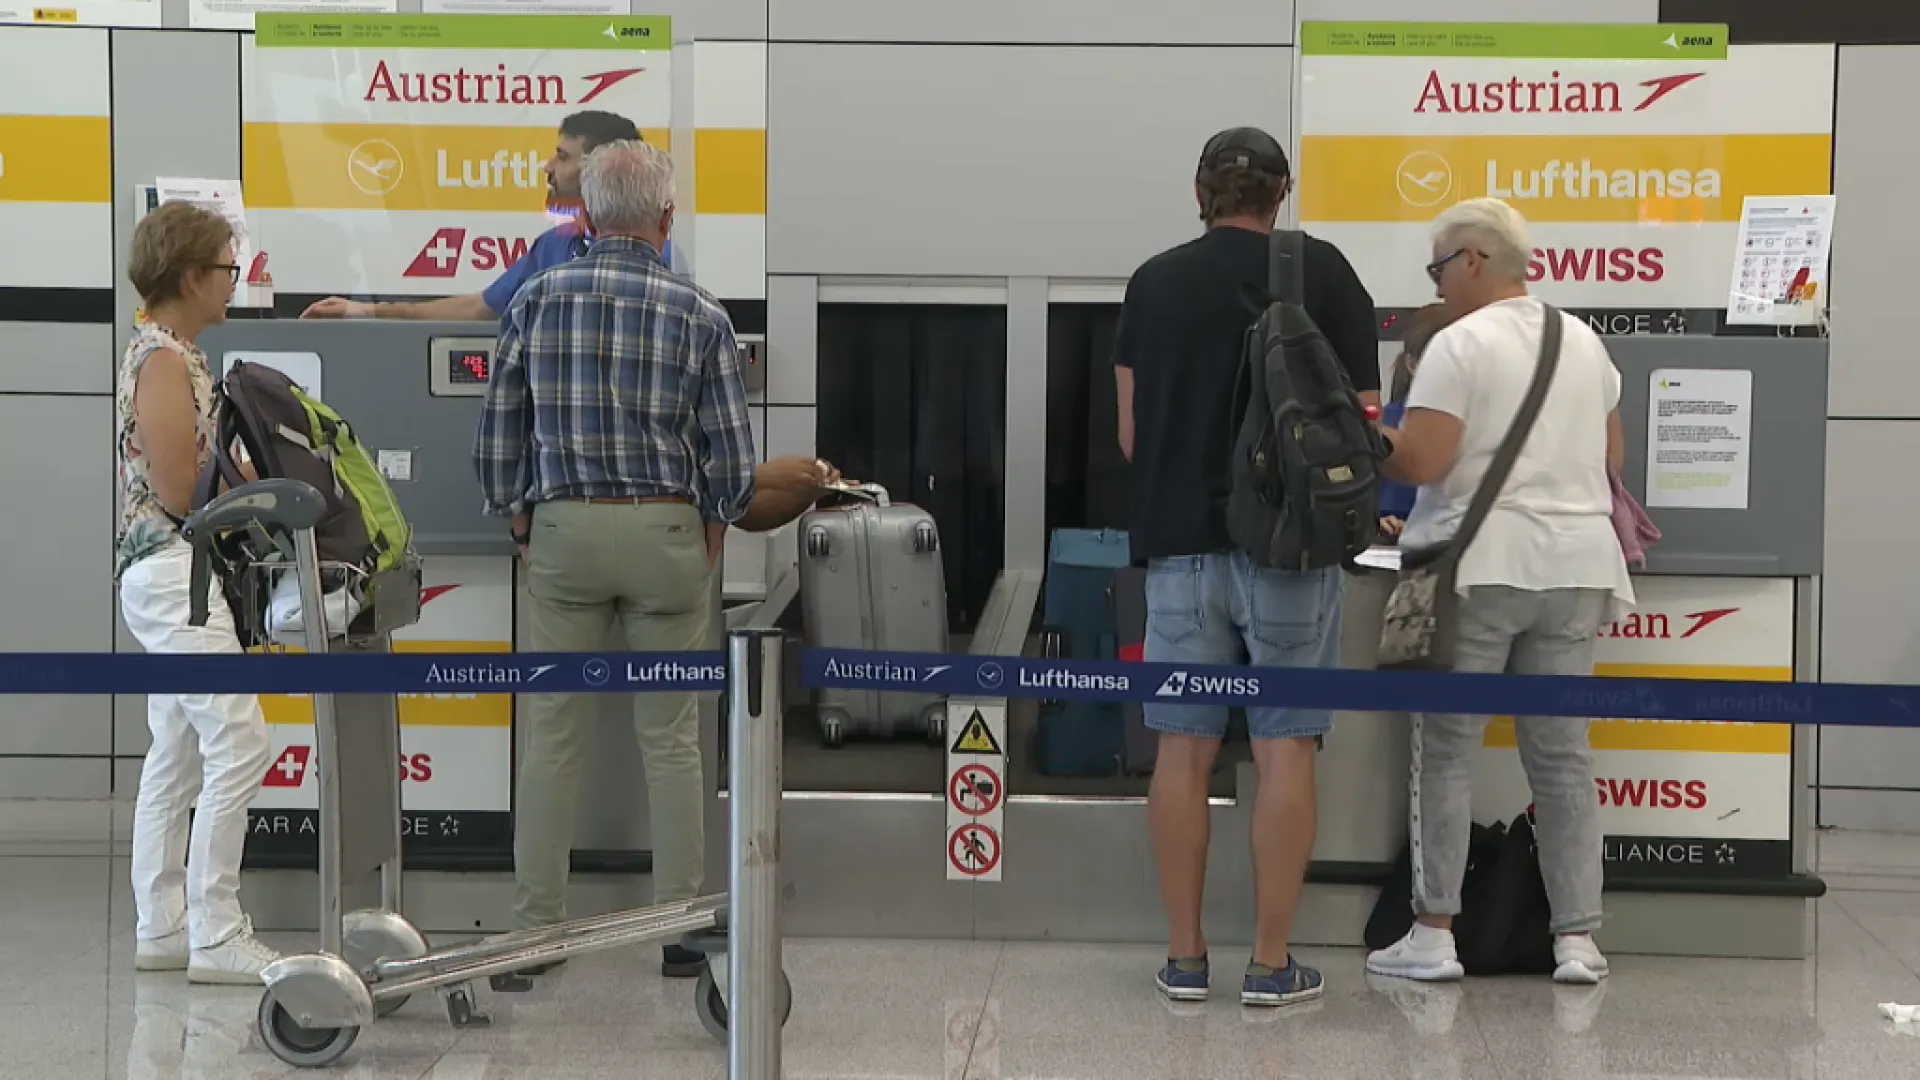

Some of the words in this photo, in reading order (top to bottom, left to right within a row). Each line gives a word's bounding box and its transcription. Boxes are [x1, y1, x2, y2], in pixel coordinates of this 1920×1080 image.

[620, 25, 650, 37] aena
[1682, 35, 1713, 46] aena
[364, 60, 567, 104] Austrian
[1414, 70, 1623, 113] Austrian
[437, 149, 549, 189] Lufth
[1486, 159, 1721, 199] Lufthansa
[425, 664, 521, 684] Austrian
[627, 662, 726, 682] Lufthans
[824, 657, 917, 683] Austrian
[1019, 667, 1130, 692] Lufthansa
[1190, 676, 1260, 696] SWISS
[1604, 843, 1704, 863] LIANCE
